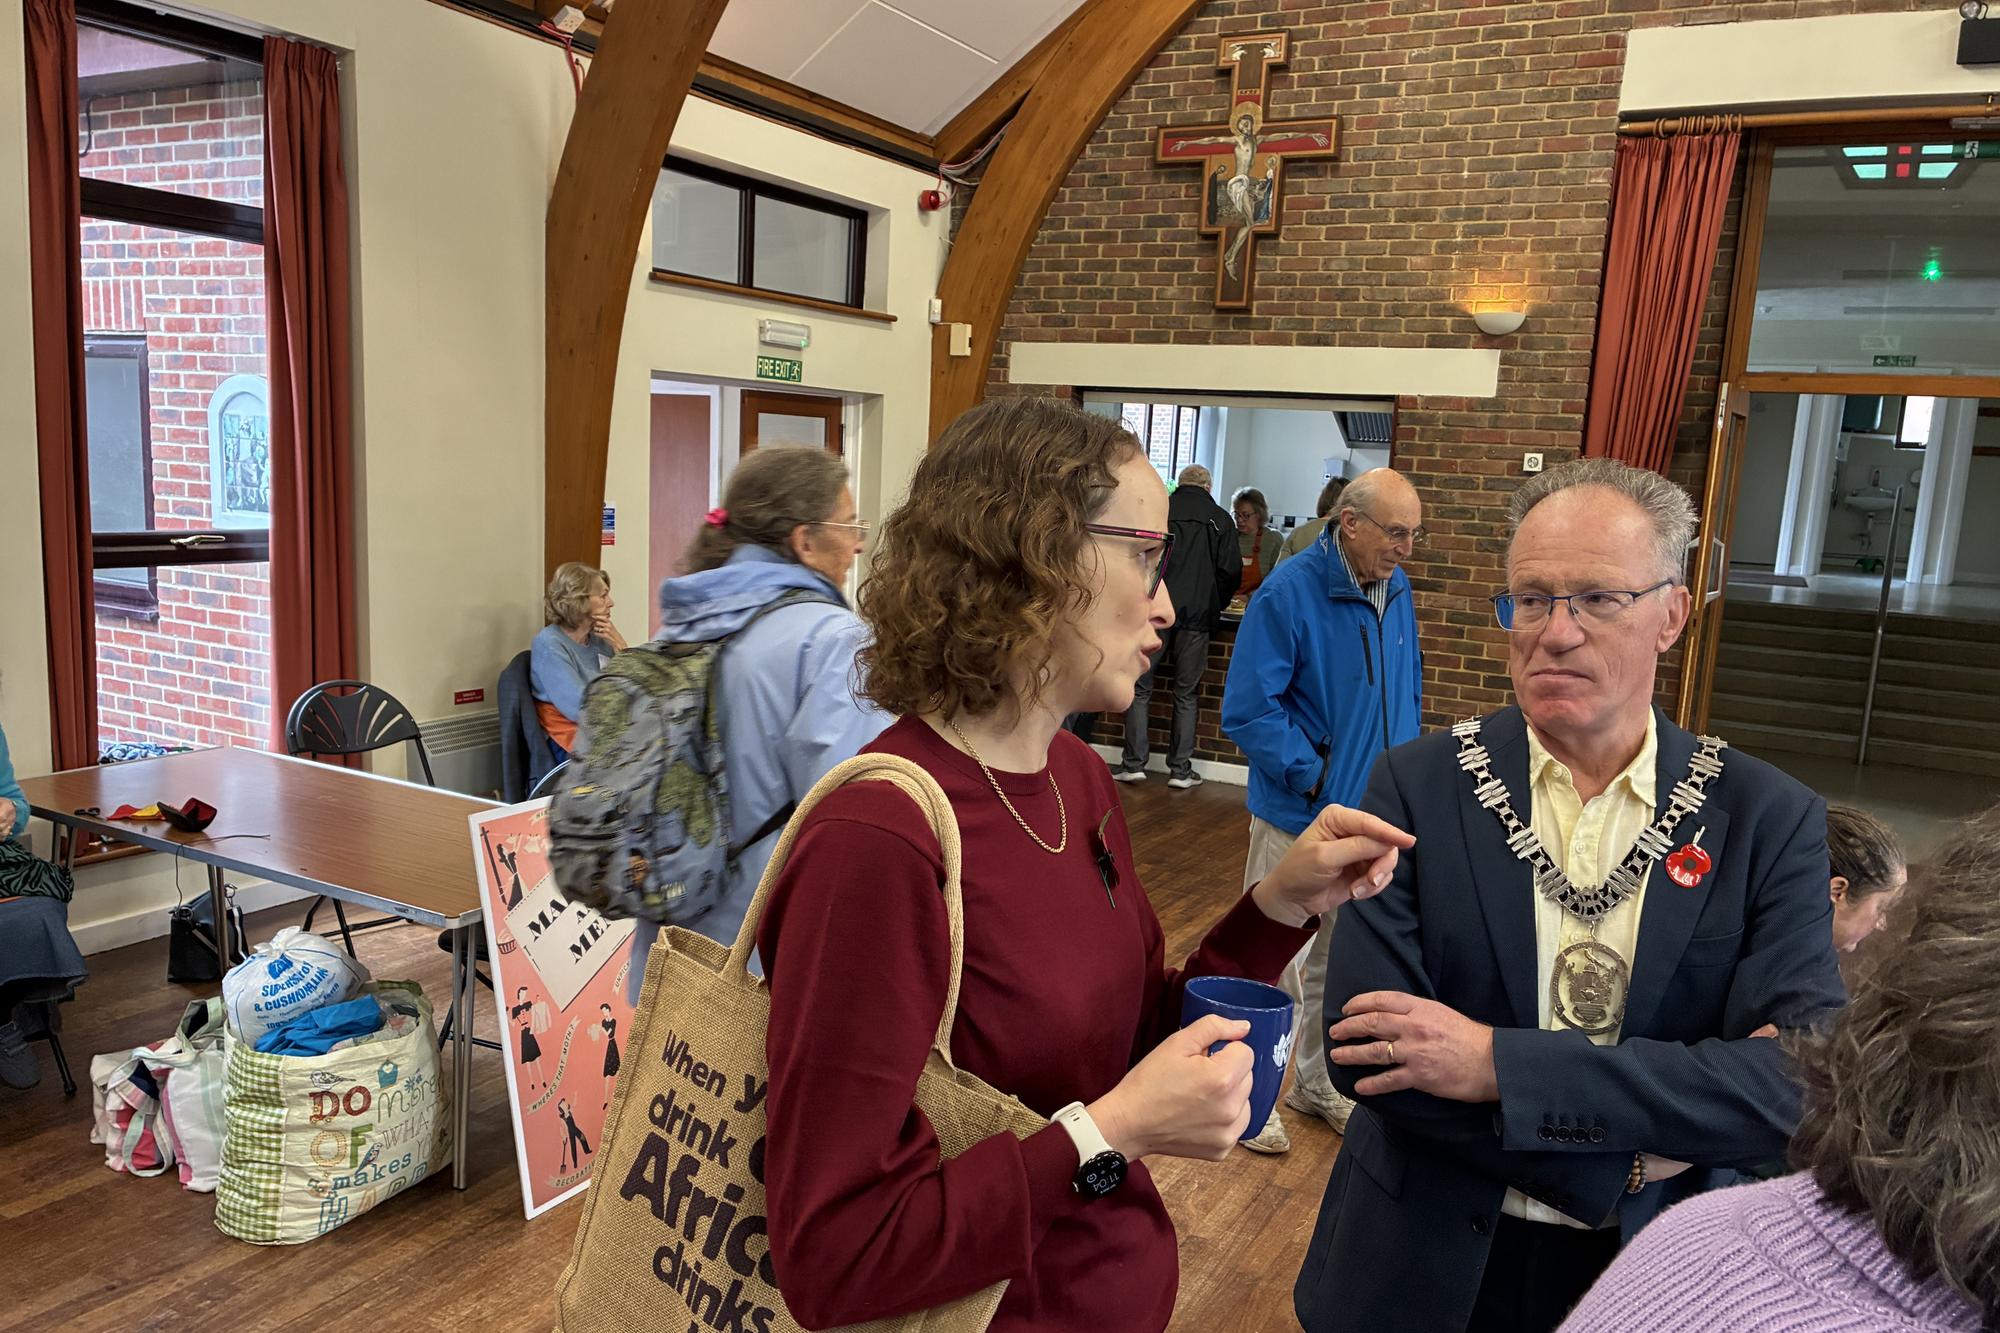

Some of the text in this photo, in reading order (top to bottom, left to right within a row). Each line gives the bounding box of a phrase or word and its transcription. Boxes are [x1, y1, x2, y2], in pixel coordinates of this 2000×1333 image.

[757, 358, 791, 378] FIRE EXIT
[556, 1059, 566, 1081] THAT
[661, 1029, 727, 1098] When
[308, 1084, 373, 1124] DO
[648, 1088, 737, 1169] drink
[310, 1101, 439, 1169] OF WHAT
[322, 1151, 412, 1192] makes
[652, 1240, 776, 1333] drinks
